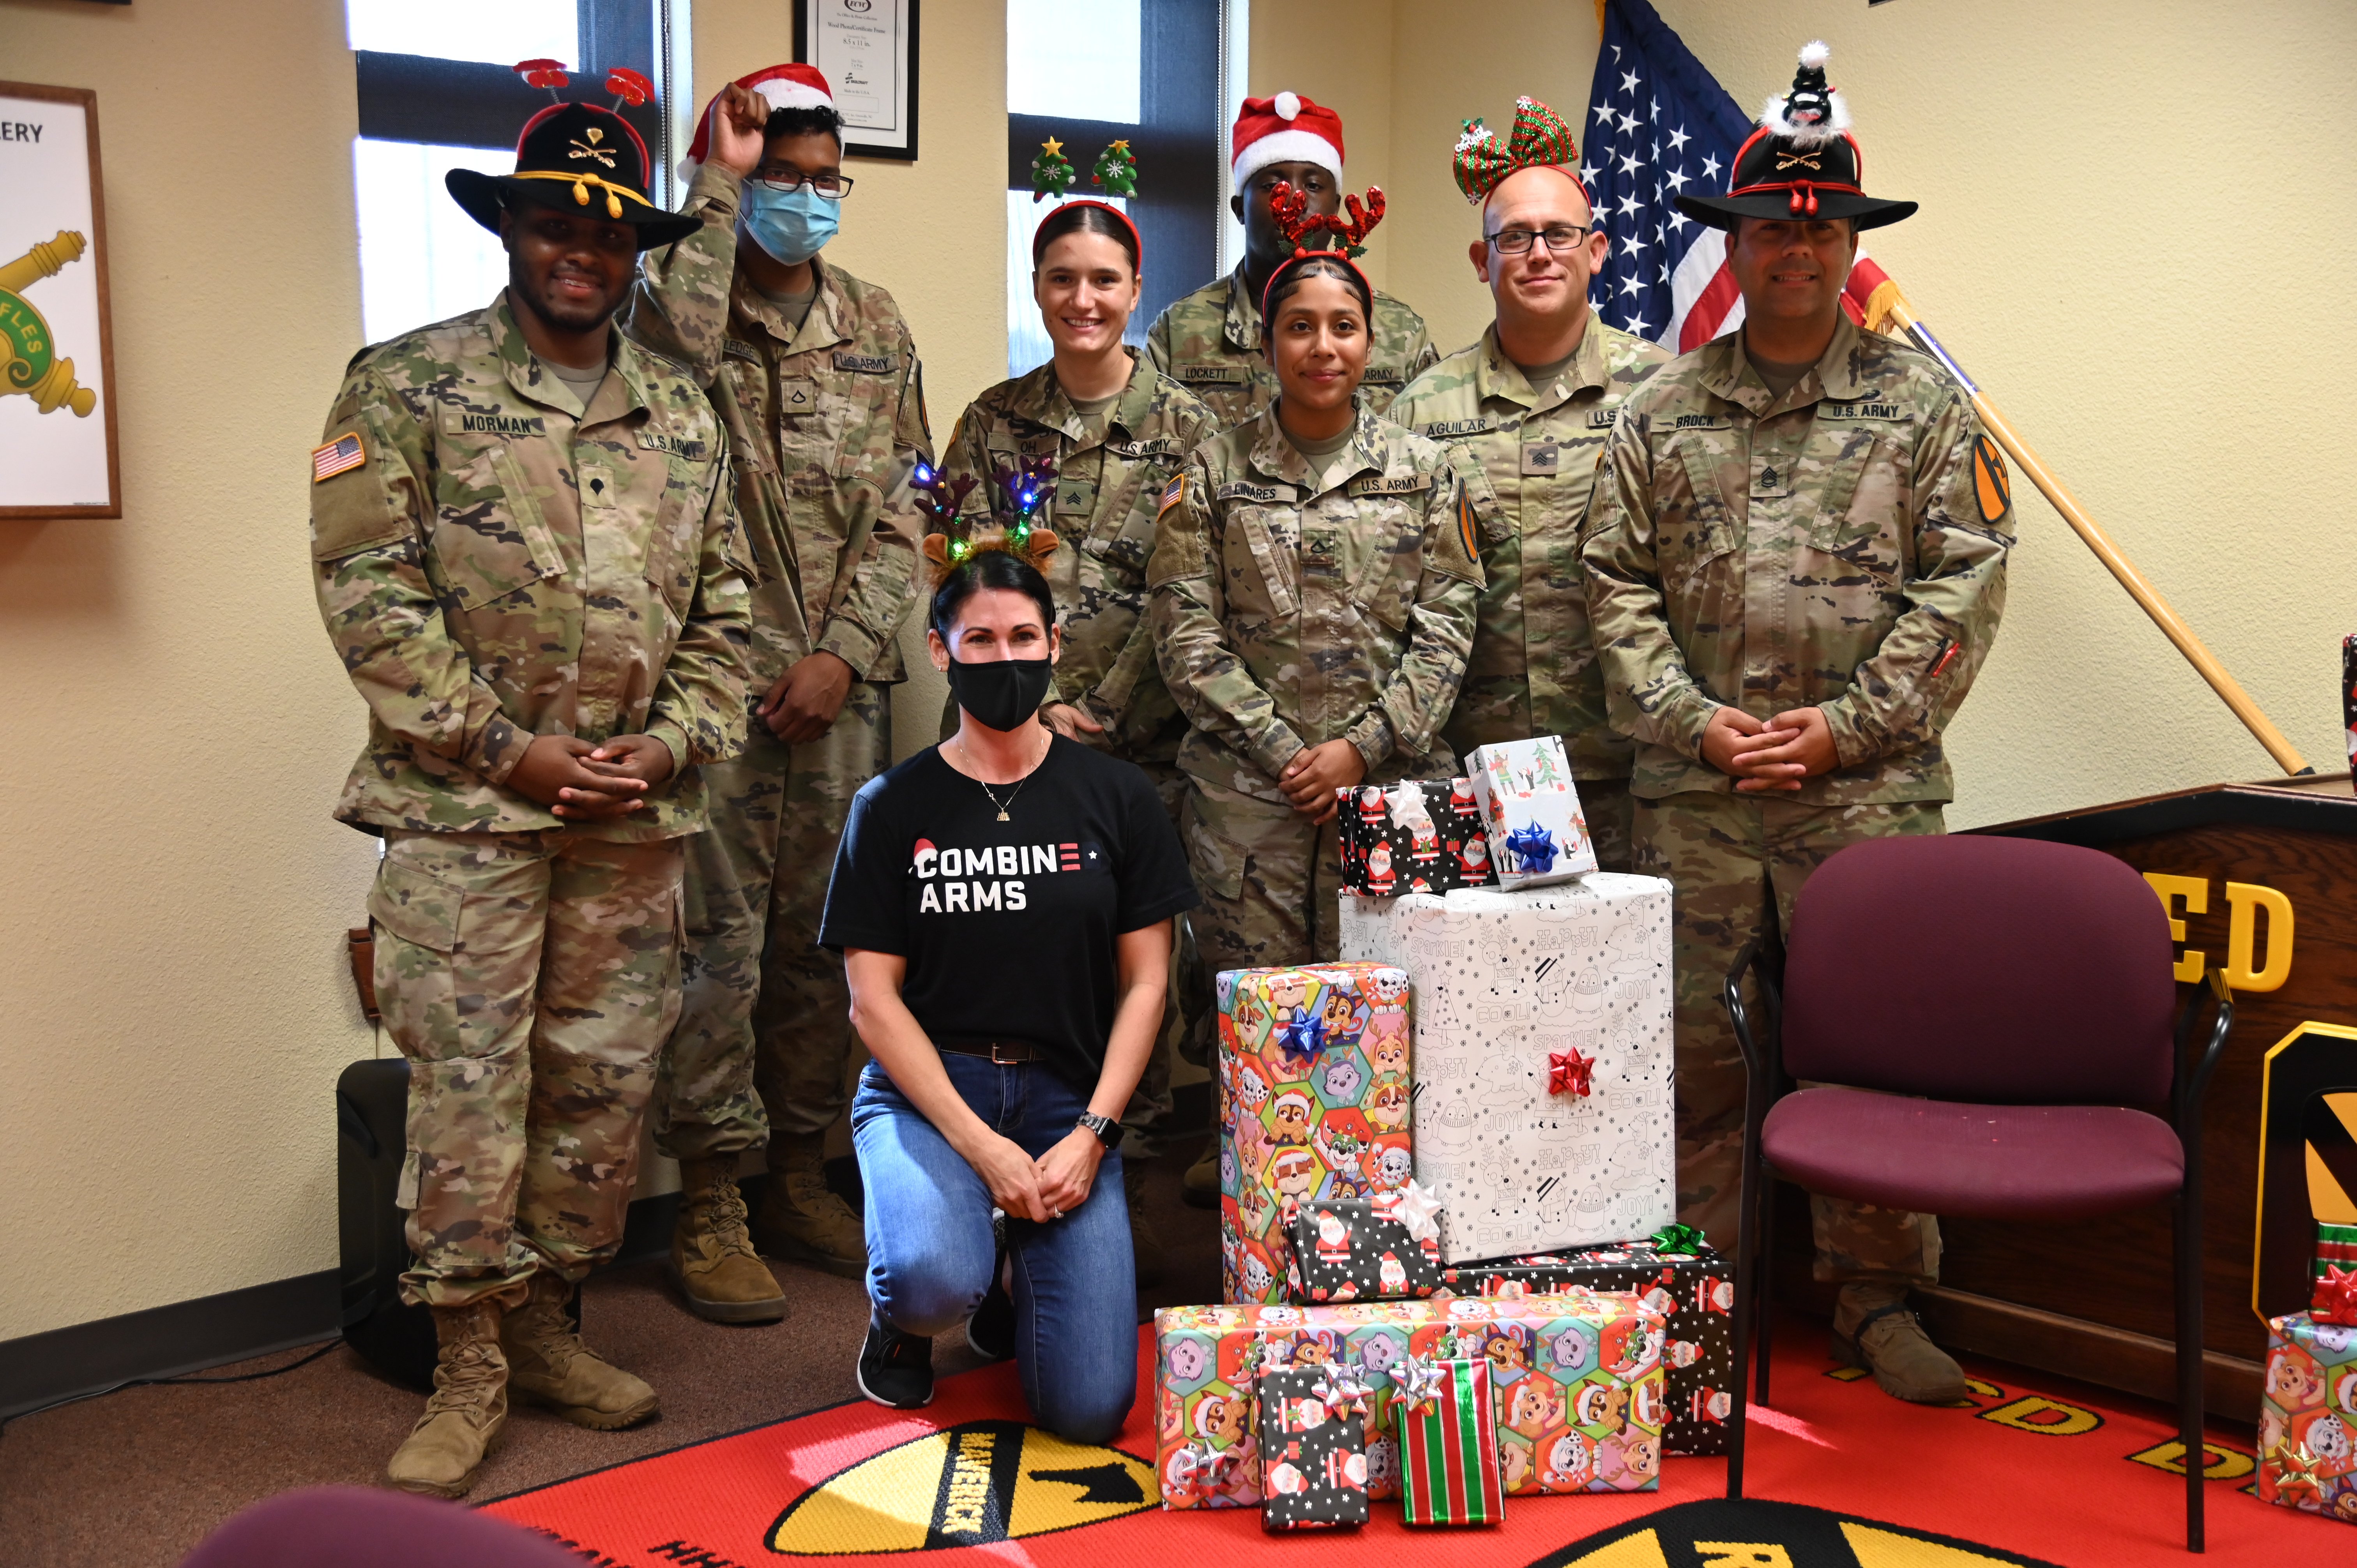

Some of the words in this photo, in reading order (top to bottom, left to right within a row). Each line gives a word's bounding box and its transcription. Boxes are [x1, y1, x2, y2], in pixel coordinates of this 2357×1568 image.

[0, 121, 43, 144] ERY
[722, 338, 754, 358] LEDGE
[861, 357, 889, 370] ARMY
[1186, 368, 1228, 379] LOCKETT
[1364, 369, 1393, 380] ARMY
[1833, 406, 1857, 418] U.S.
[1861, 405, 1899, 418] ARMY
[463, 415, 531, 434] MORMAN
[1426, 418, 1487, 437] AGUILAR
[1675, 415, 1716, 429] BROCK
[671, 437, 697, 458] ARMY
[1020, 441, 1037, 453] OH
[1141, 440, 1171, 455] ARMY
[1234, 486, 1276, 500] LINARES
[1360, 480, 1381, 492] U.S.
[1387, 477, 1419, 491] ARMY
[920, 881, 1027, 913] ARMS
[1537, 926, 1598, 955] Happy!
[1615, 979, 1651, 1000] JOY!
[1476, 1002, 1530, 1024] COOL!
[1411, 1052, 1467, 1086] Happy!
[1609, 1088, 1661, 1110] COOL!
[1484, 1111, 1523, 1132] JOY!
[1539, 1143, 1601, 1174] Happy!
[1617, 1195, 1653, 1216] JOY!
[1477, 1222, 1532, 1245] COOL!
